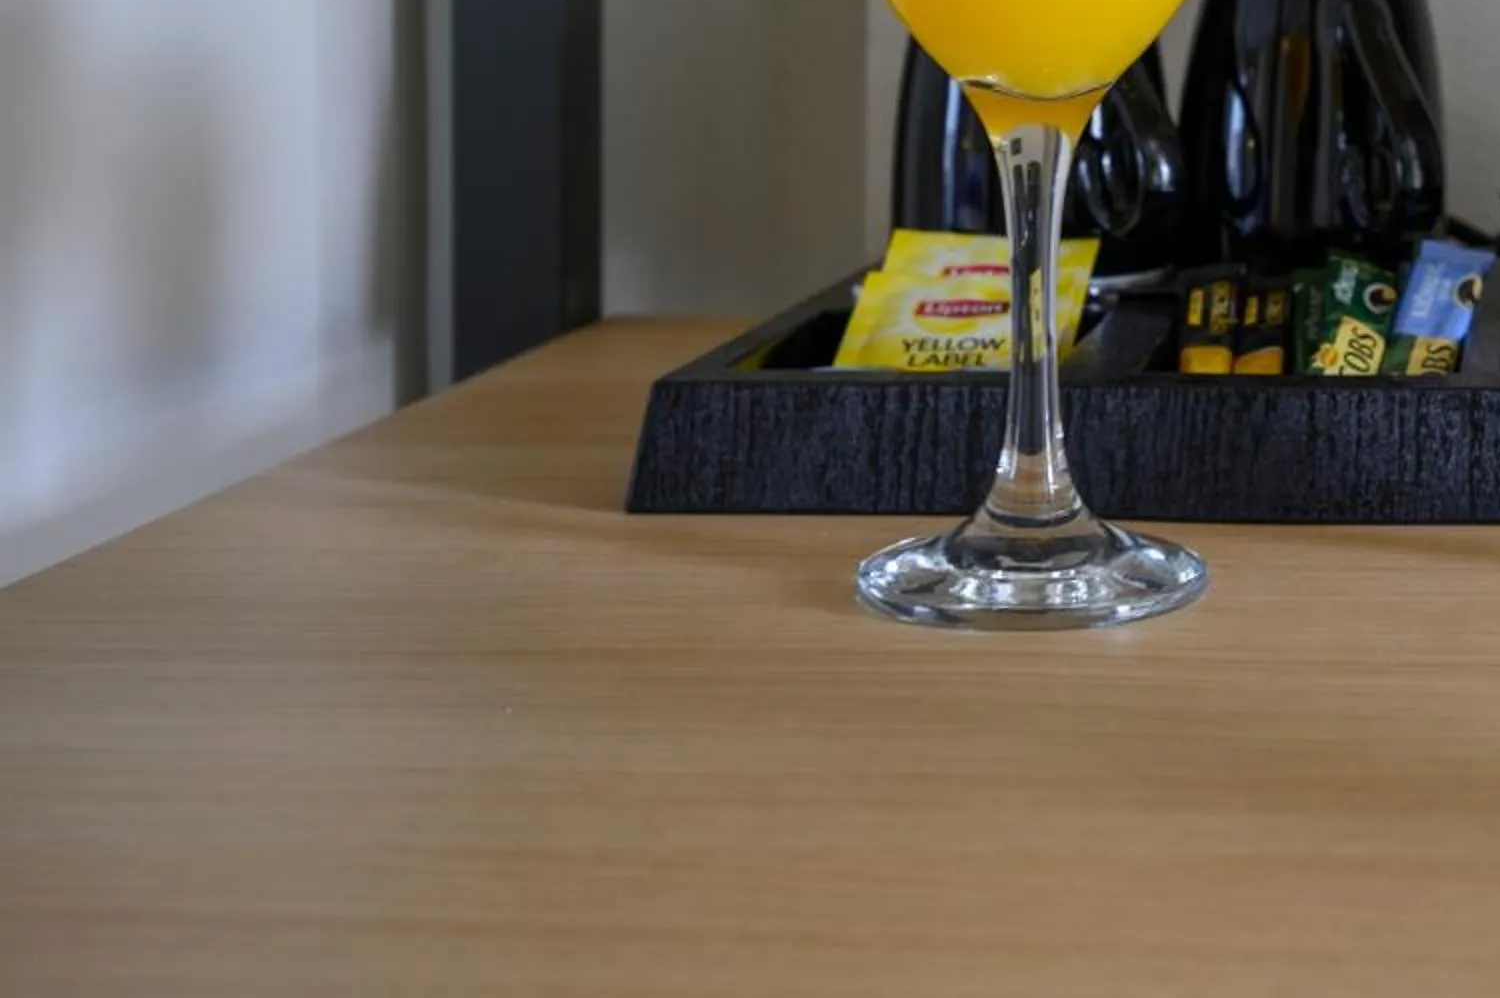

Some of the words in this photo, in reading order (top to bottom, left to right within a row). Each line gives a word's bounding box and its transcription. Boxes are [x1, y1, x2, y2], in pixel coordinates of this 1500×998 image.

[922, 302, 1003, 316] Lipton
[902, 336, 1005, 351] YELLOW
[1339, 326, 1377, 376] OBS
[907, 353, 986, 368] LABEL
